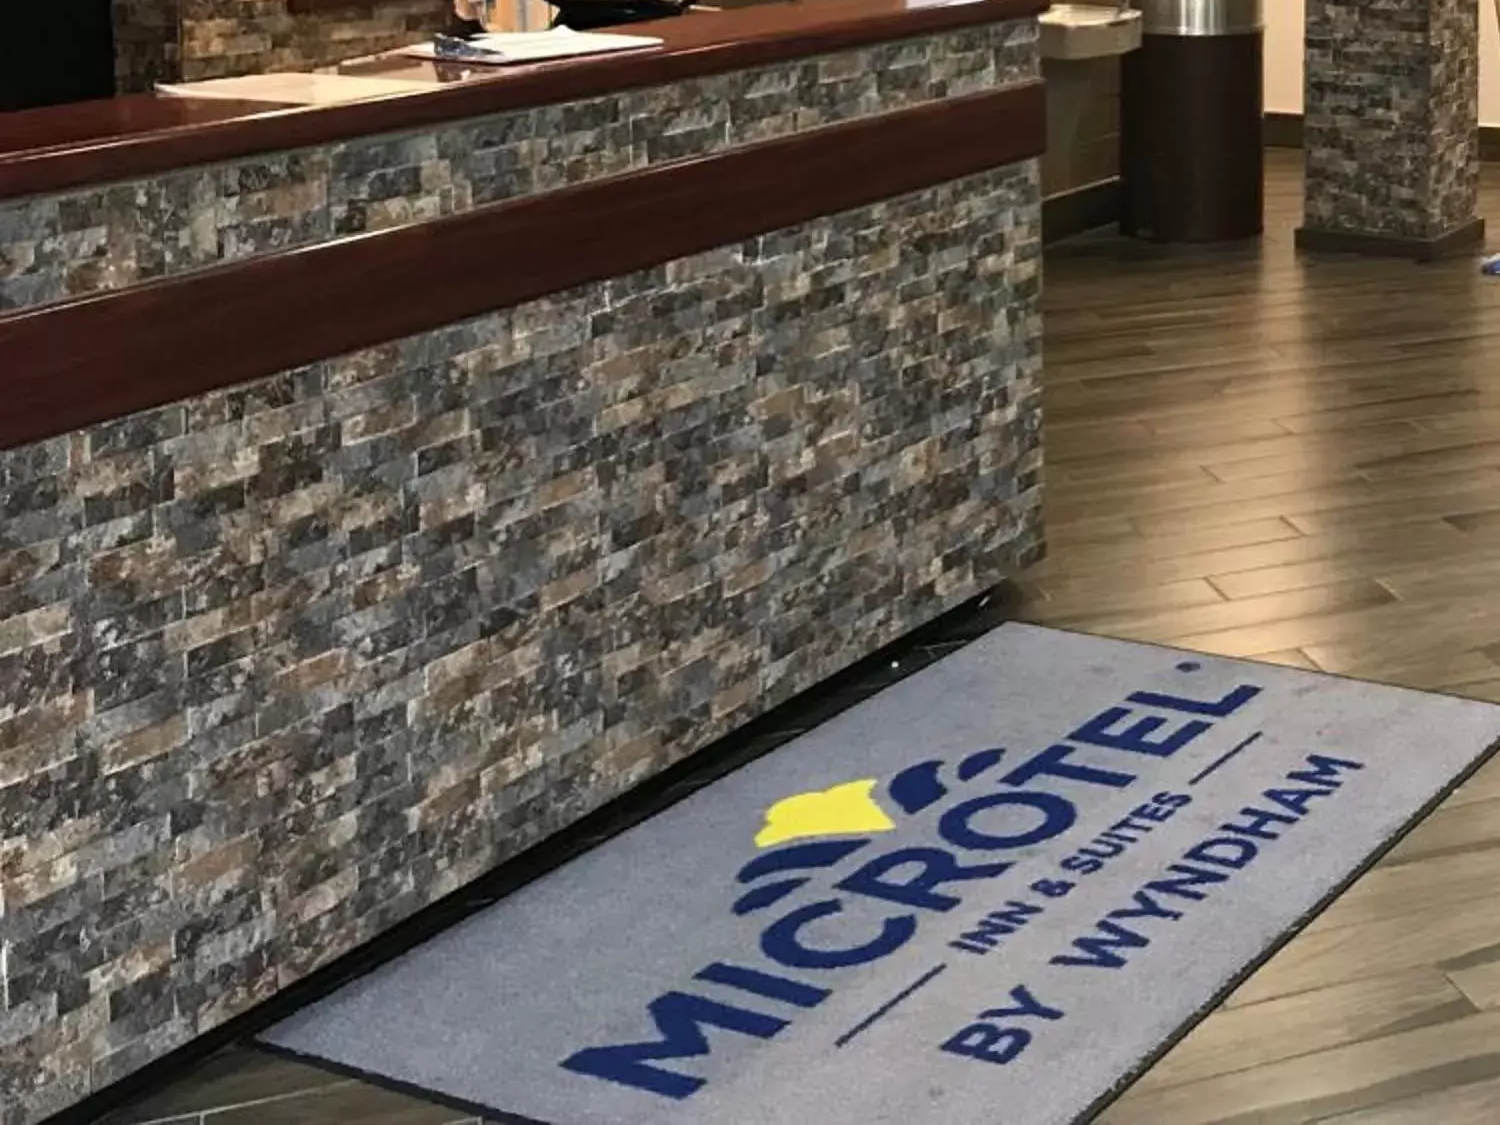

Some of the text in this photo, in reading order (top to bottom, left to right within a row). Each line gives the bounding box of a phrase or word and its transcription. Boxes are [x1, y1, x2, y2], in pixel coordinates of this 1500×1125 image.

[558, 682, 1264, 1100] MICROTEL
[940, 754, 1365, 1065] BY WYNDHAM
[948, 790, 1194, 955] INN & SUITES
